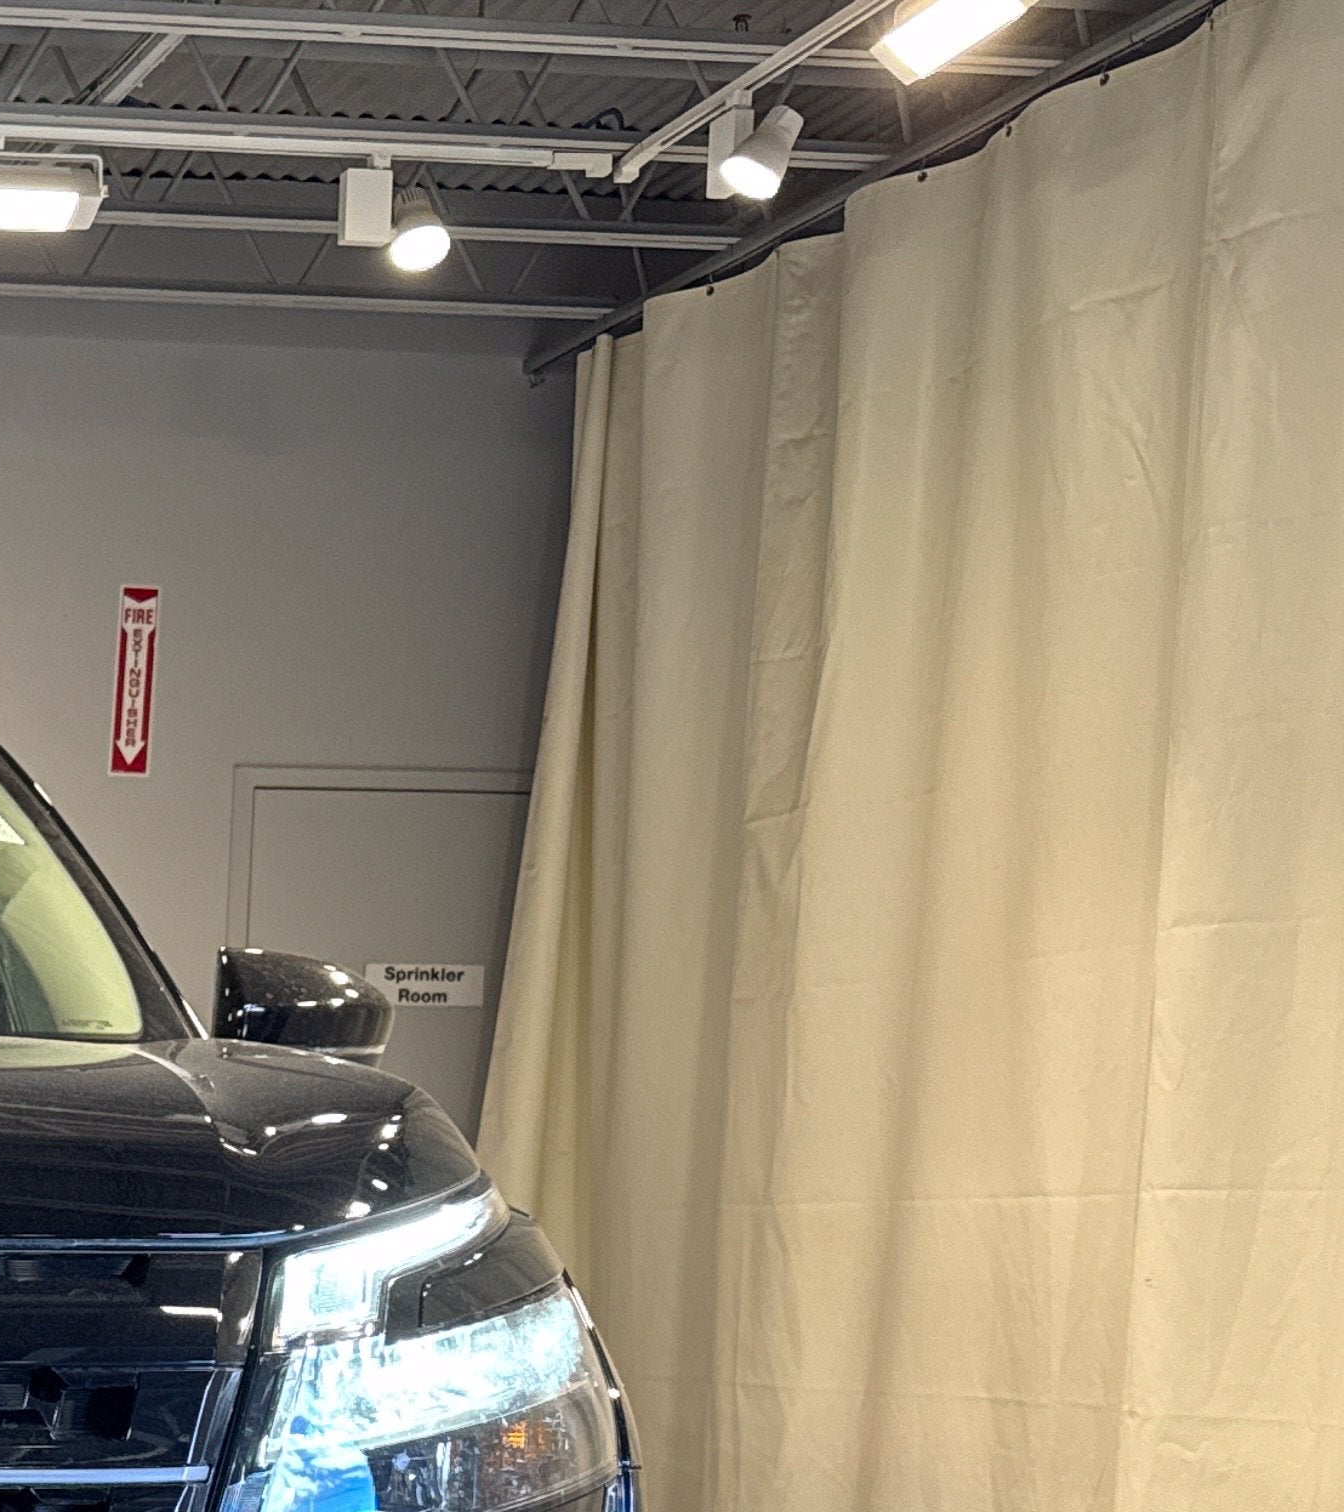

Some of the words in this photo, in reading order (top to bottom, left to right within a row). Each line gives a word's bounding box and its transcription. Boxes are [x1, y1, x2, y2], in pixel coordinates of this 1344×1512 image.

[124, 608, 154, 625] FIRE
[125, 628, 143, 747] EXTINGUISHER
[384, 966, 464, 983] Sprinkler
[398, 988, 448, 1004] Room
